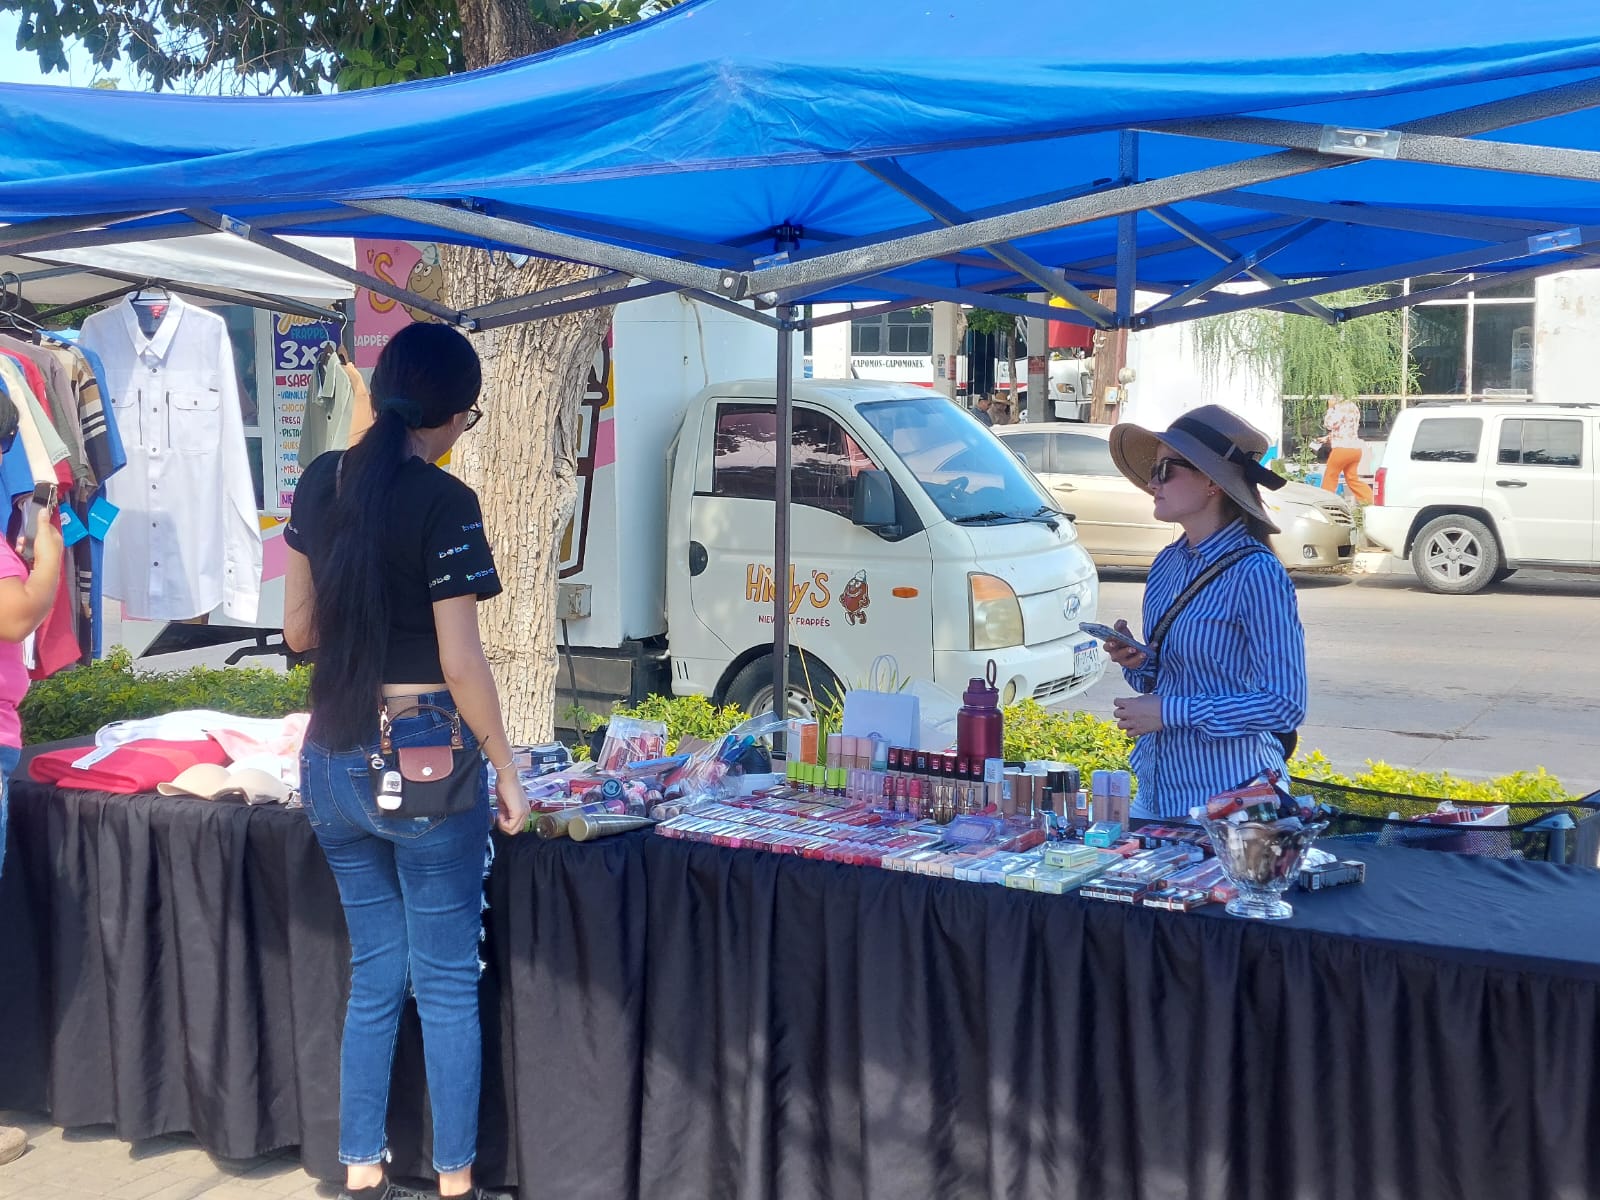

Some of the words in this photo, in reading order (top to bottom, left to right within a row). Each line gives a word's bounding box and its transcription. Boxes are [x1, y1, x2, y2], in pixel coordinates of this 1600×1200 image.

[282, 440, 300, 450] QUES
[461, 521, 482, 532] beb
[796, 616, 831, 627] FRAPPÉS
